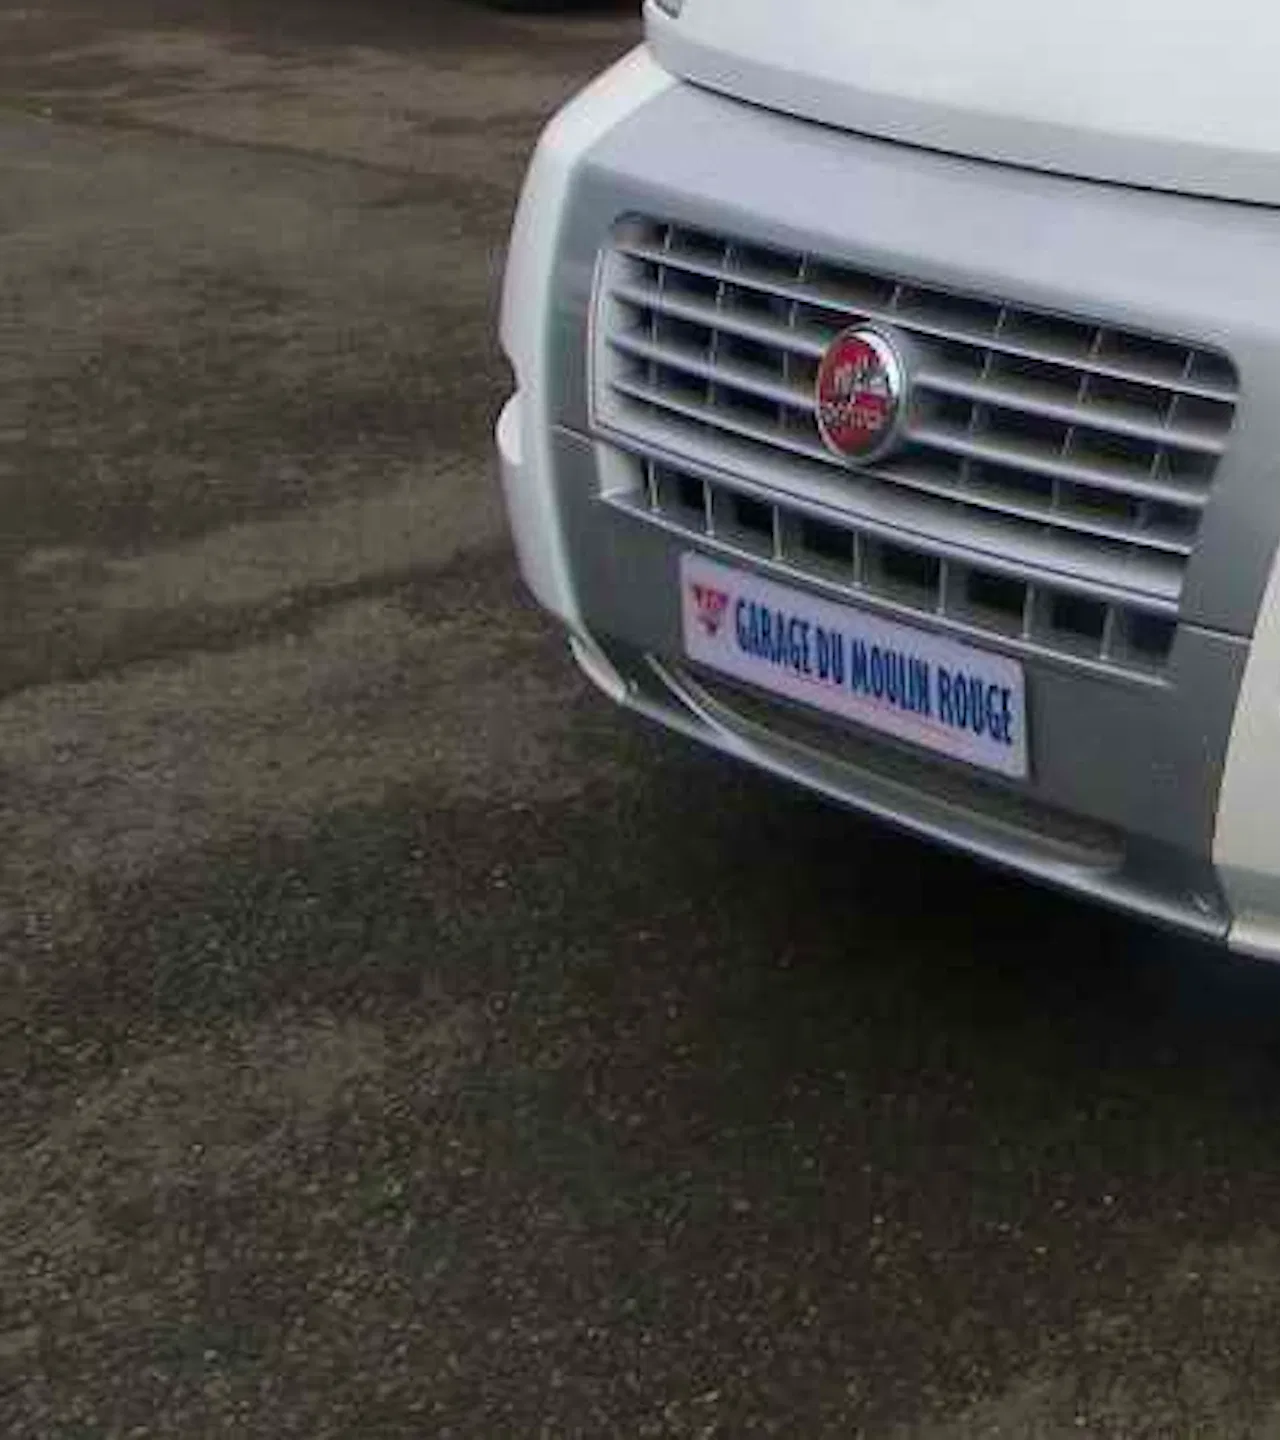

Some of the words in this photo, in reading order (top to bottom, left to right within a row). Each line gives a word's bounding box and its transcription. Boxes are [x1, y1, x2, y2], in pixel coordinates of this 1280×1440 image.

[735, 597, 811, 675] GARAGE
[815, 626, 842, 685] DU
[851, 640, 929, 717] MOULIN
[936, 665, 1013, 747] ROUGE
